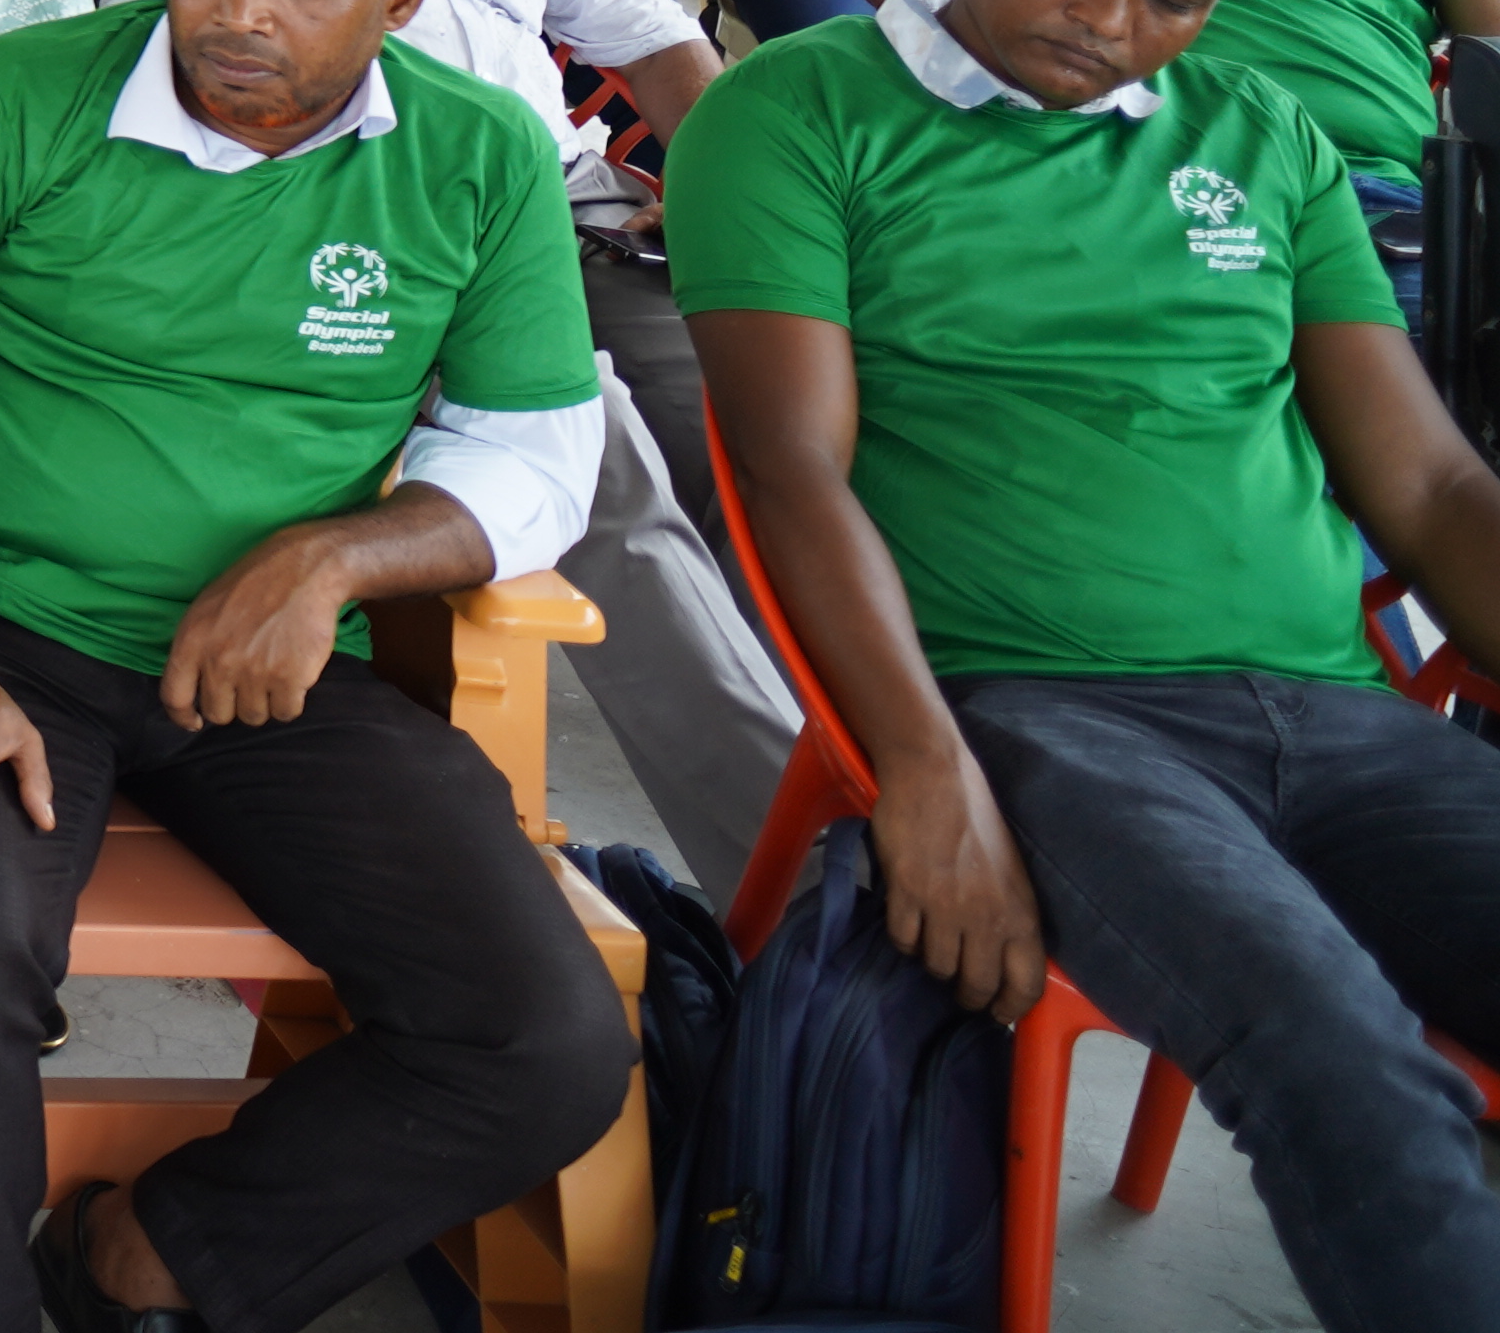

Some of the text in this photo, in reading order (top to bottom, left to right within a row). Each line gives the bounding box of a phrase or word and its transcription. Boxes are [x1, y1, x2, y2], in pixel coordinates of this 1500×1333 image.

[306, 306, 390, 325] Special
[298, 321, 396, 341] Olympics
[308, 340, 384, 357] Bangladesh
